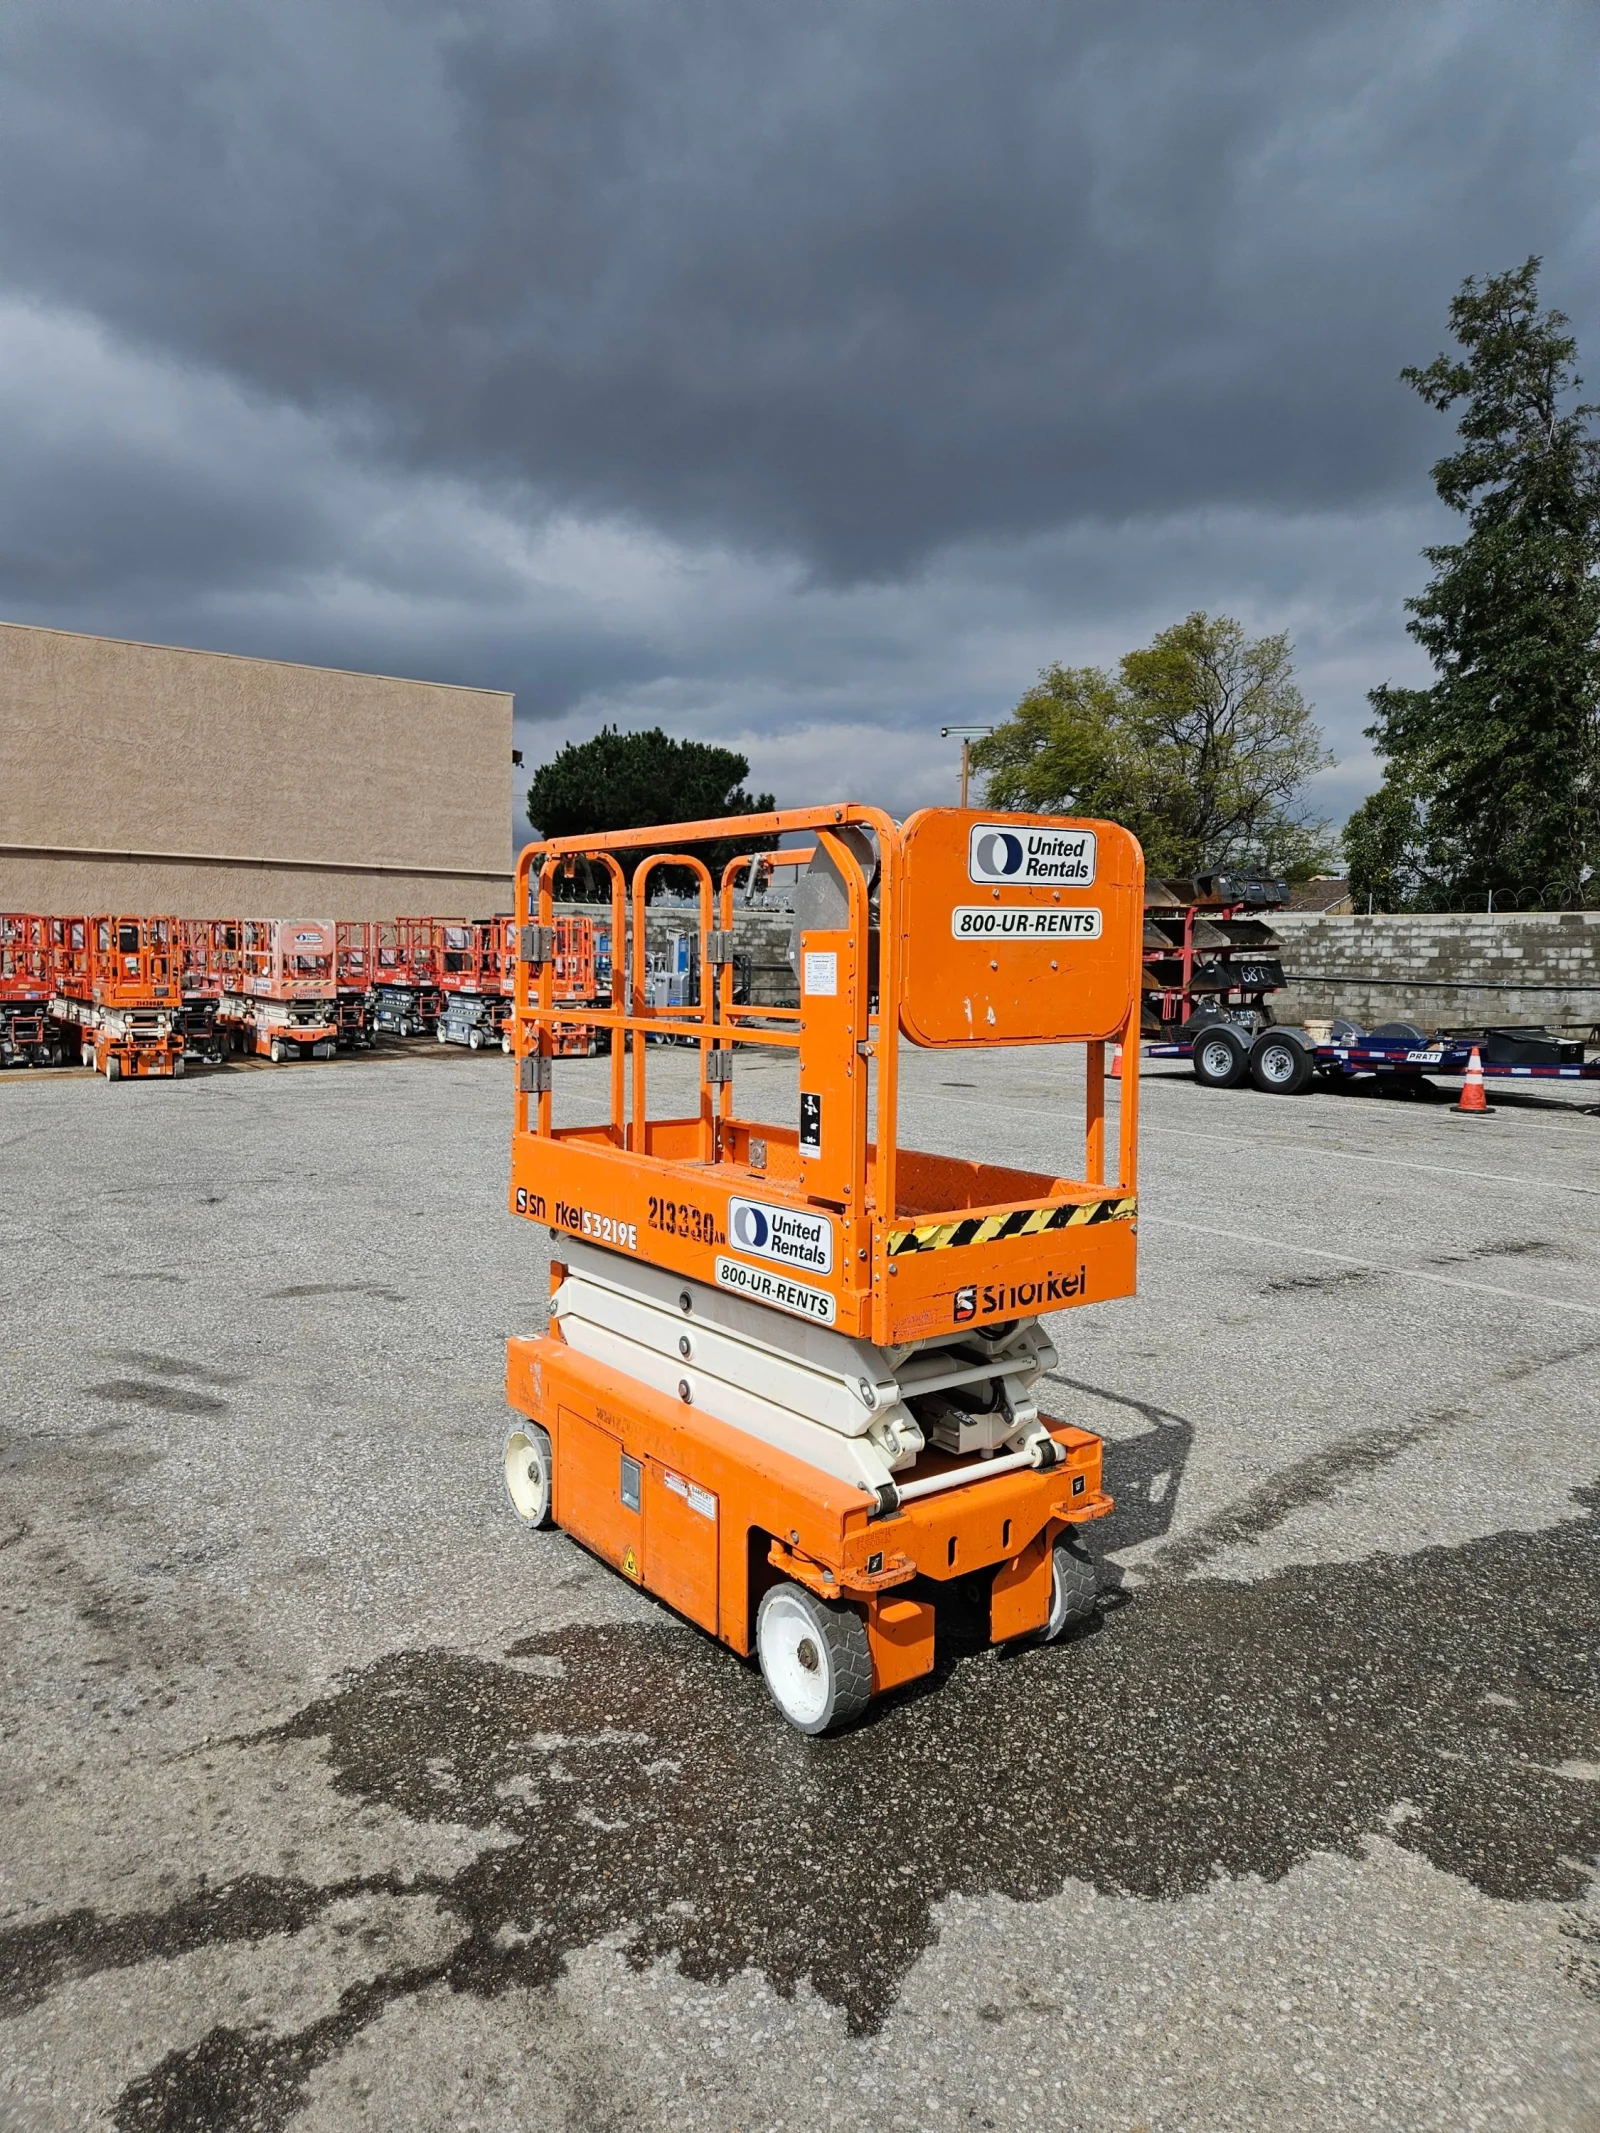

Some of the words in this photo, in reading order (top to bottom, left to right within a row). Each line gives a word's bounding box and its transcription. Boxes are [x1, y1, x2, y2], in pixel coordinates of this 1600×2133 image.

[1027, 836, 1085, 857] United
[1025, 858, 1089, 878] Rentals
[960, 914, 1095, 932] 800-UR-RENTS
[1409, 1052, 1440, 1061] PRATT
[529, 1194, 583, 1231] snrkel
[583, 1210, 637, 1251] S3219E
[771, 1214, 822, 1242] United
[771, 1235, 826, 1265] Rentals
[721, 1264, 829, 1316] 800-UR-RENTS
